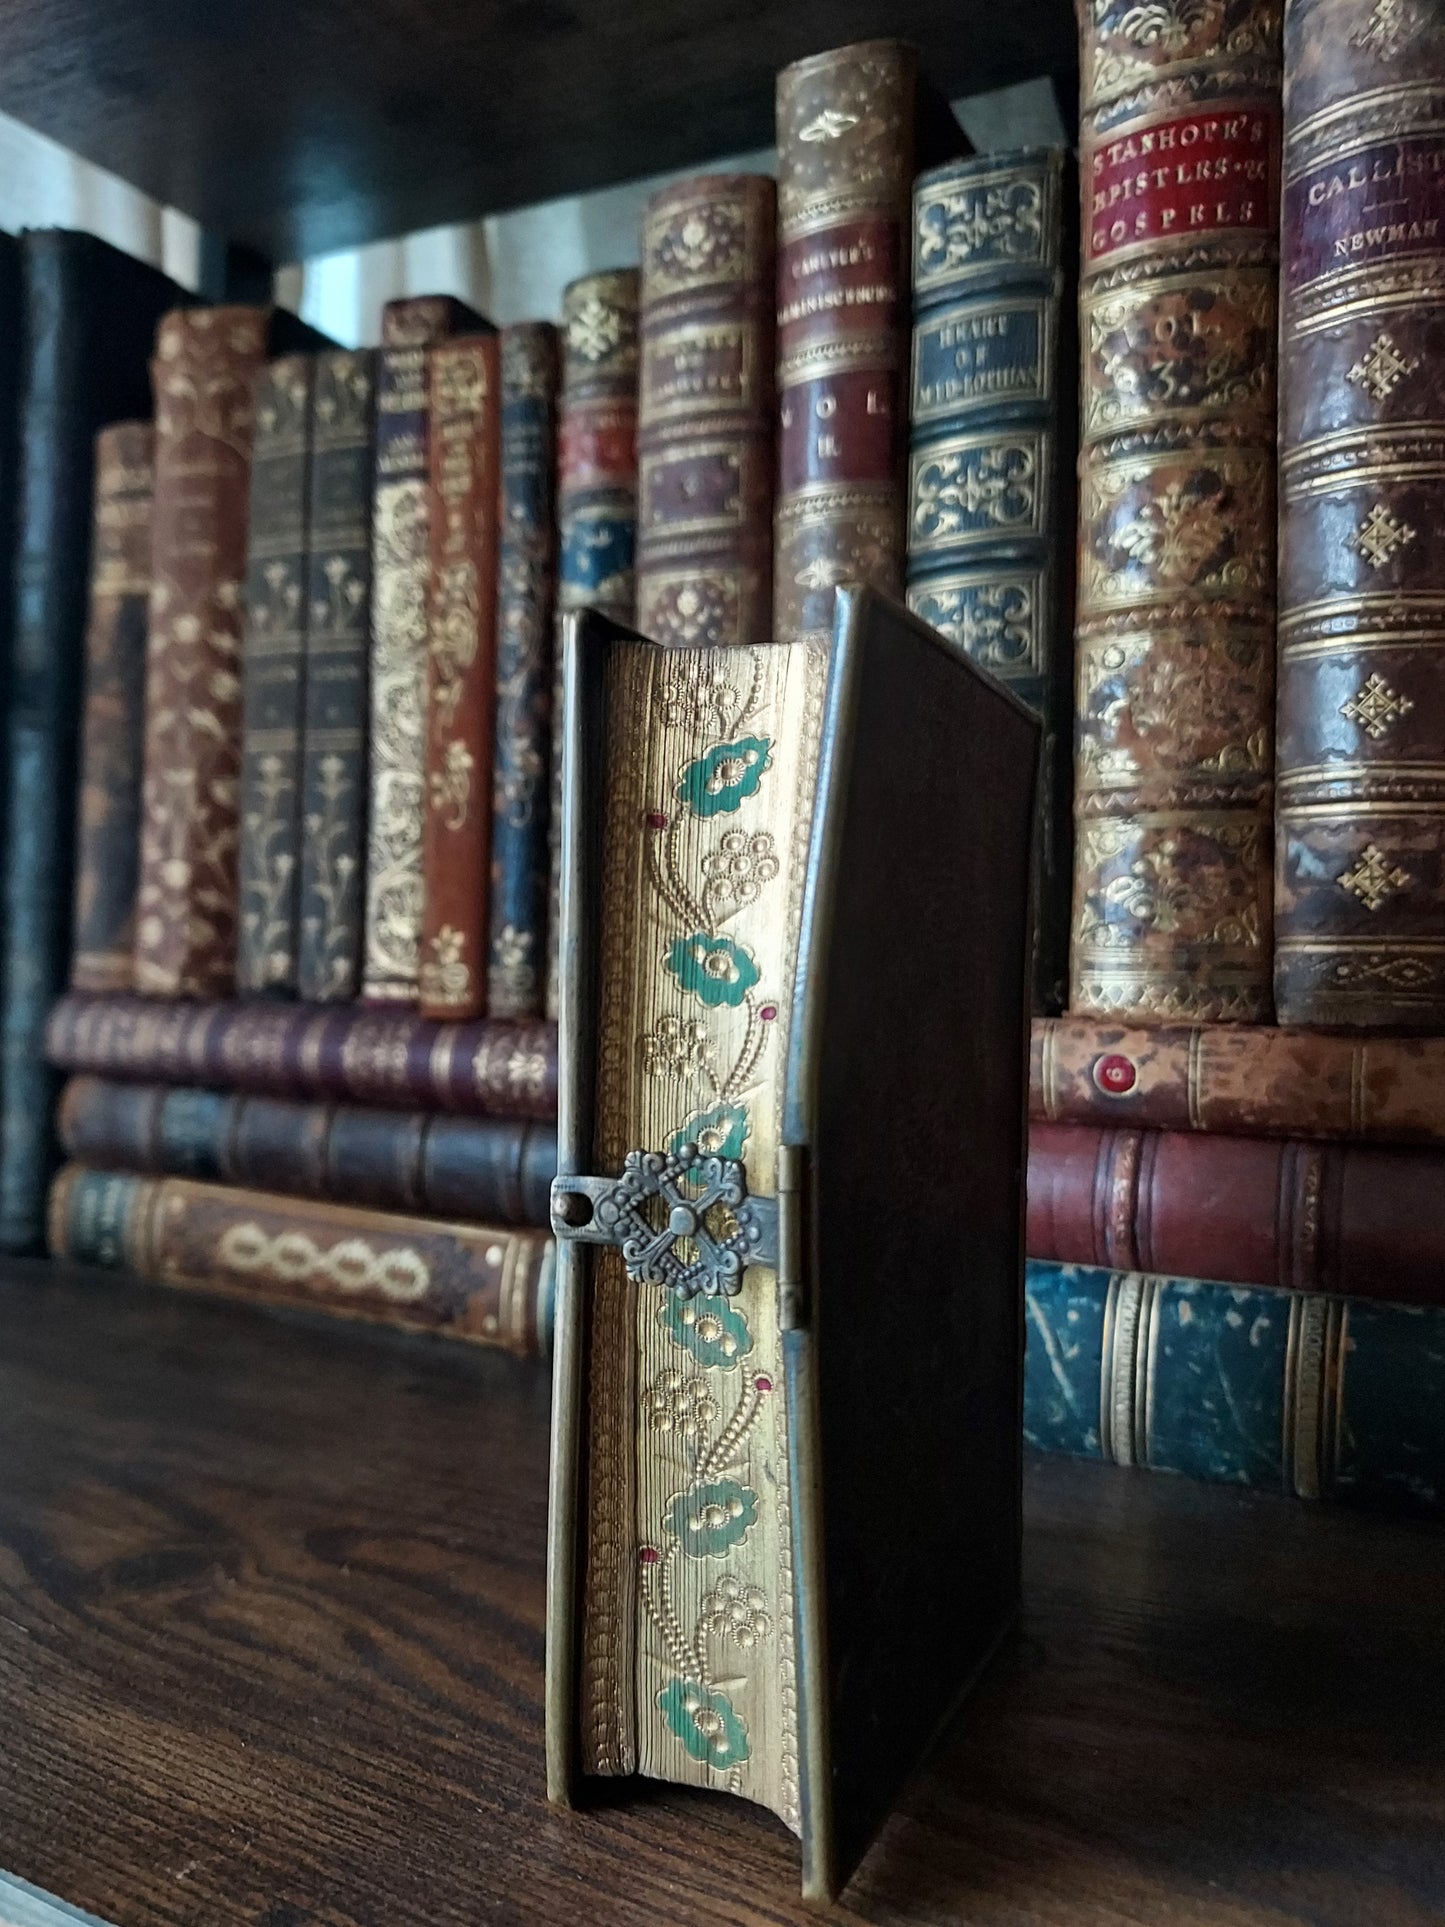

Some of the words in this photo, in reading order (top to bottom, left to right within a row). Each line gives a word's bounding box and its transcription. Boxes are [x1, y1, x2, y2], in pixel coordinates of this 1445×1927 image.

[1093, 114, 1263, 176] STANHOPE'S
[1092, 202, 1254, 250] GOSPELS
[1333, 218, 1440, 257] NEWMAN
[955, 344, 987, 370] OF
